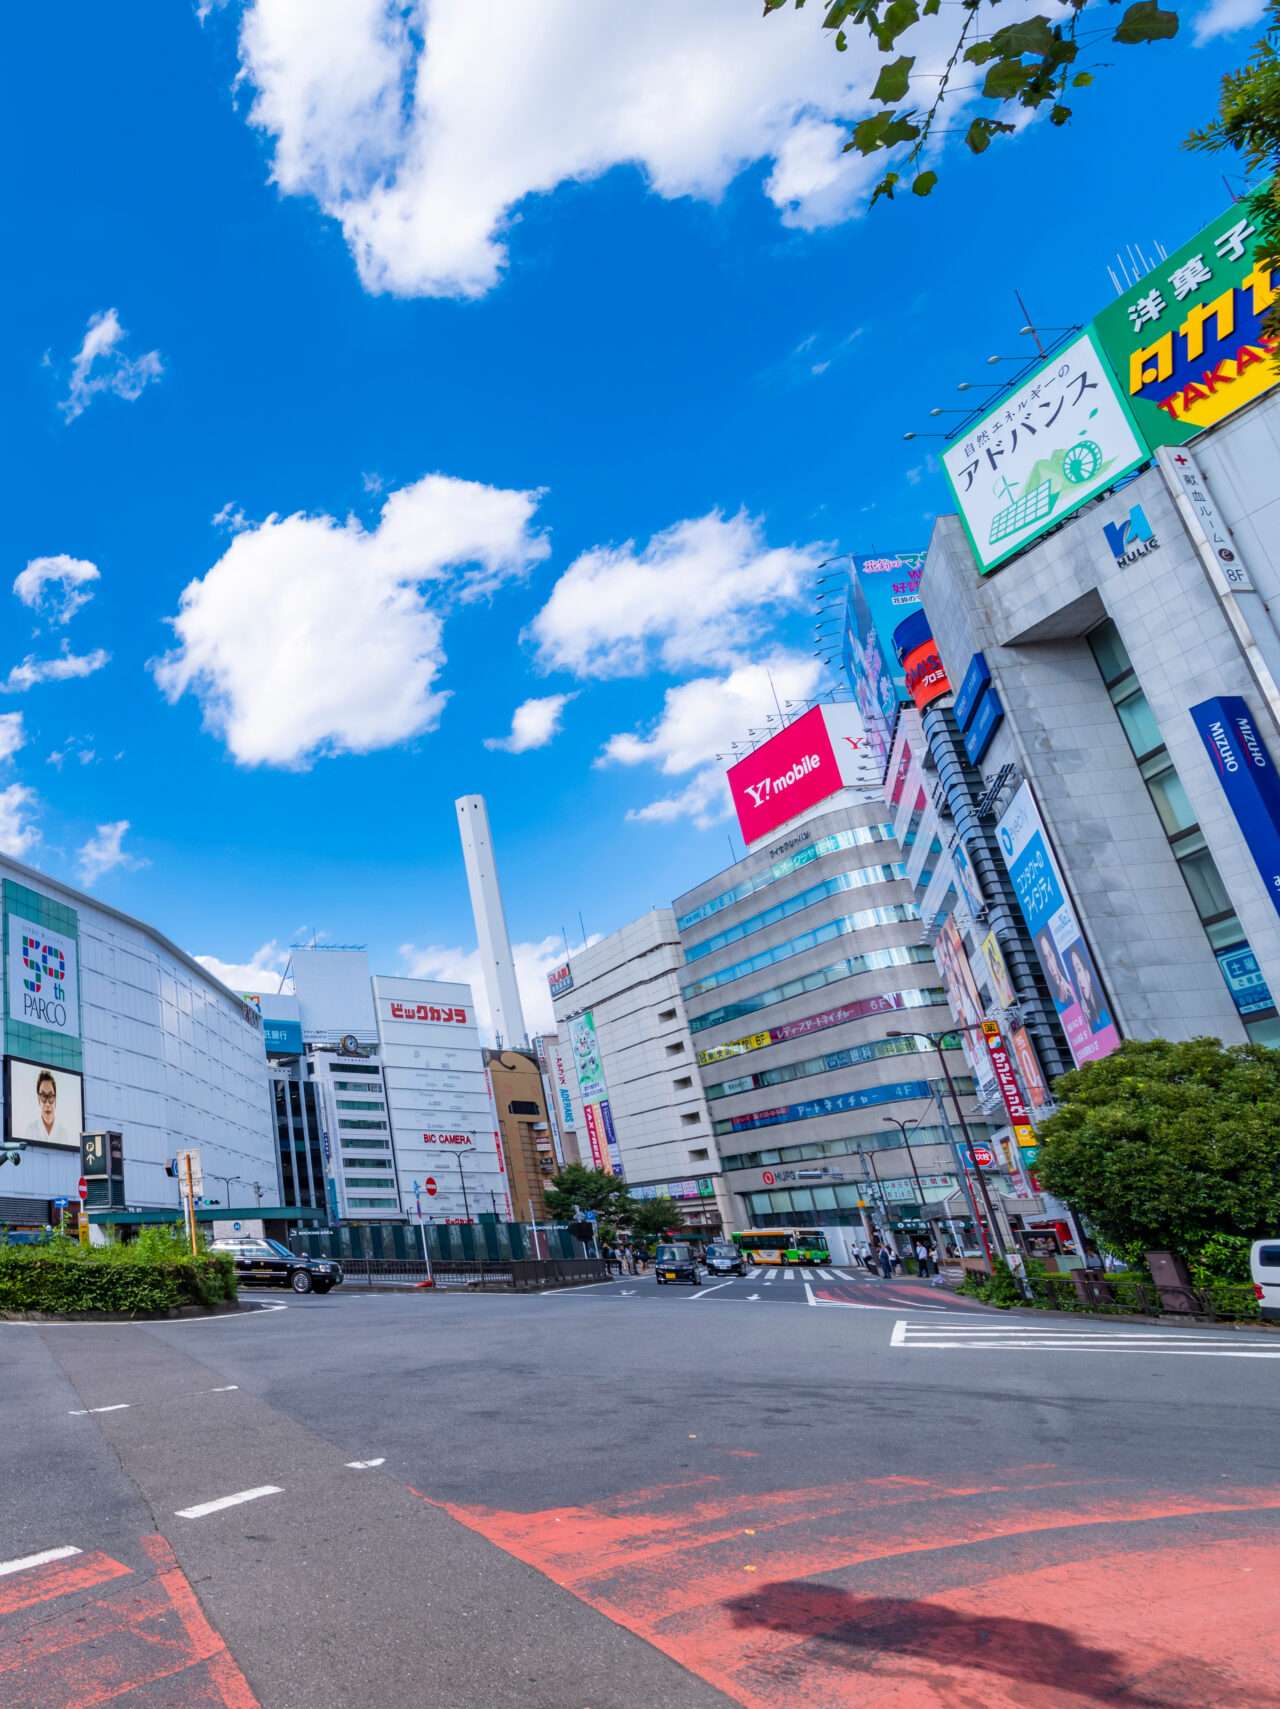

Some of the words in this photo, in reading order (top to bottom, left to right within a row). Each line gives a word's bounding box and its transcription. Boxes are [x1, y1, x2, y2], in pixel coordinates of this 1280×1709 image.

[1128, 218, 1257, 333] 洋菓子
[957, 370, 1099, 492] アドバンス
[964, 363, 1071, 458] 自然エネルギーの
[1183, 474, 1224, 544] 献血ルーム
[1117, 537, 1161, 568] HULIC
[1226, 568, 1244, 582] 8F
[1209, 722, 1239, 773] MIZUHO
[1235, 717, 1266, 768] MIZUHO
[24, 993, 67, 1027] PARCO
[391, 1002, 467, 1024] ビックカメラ
[423, 1134, 437, 1143] BIC
[439, 1135, 472, 1145] CAMERA
